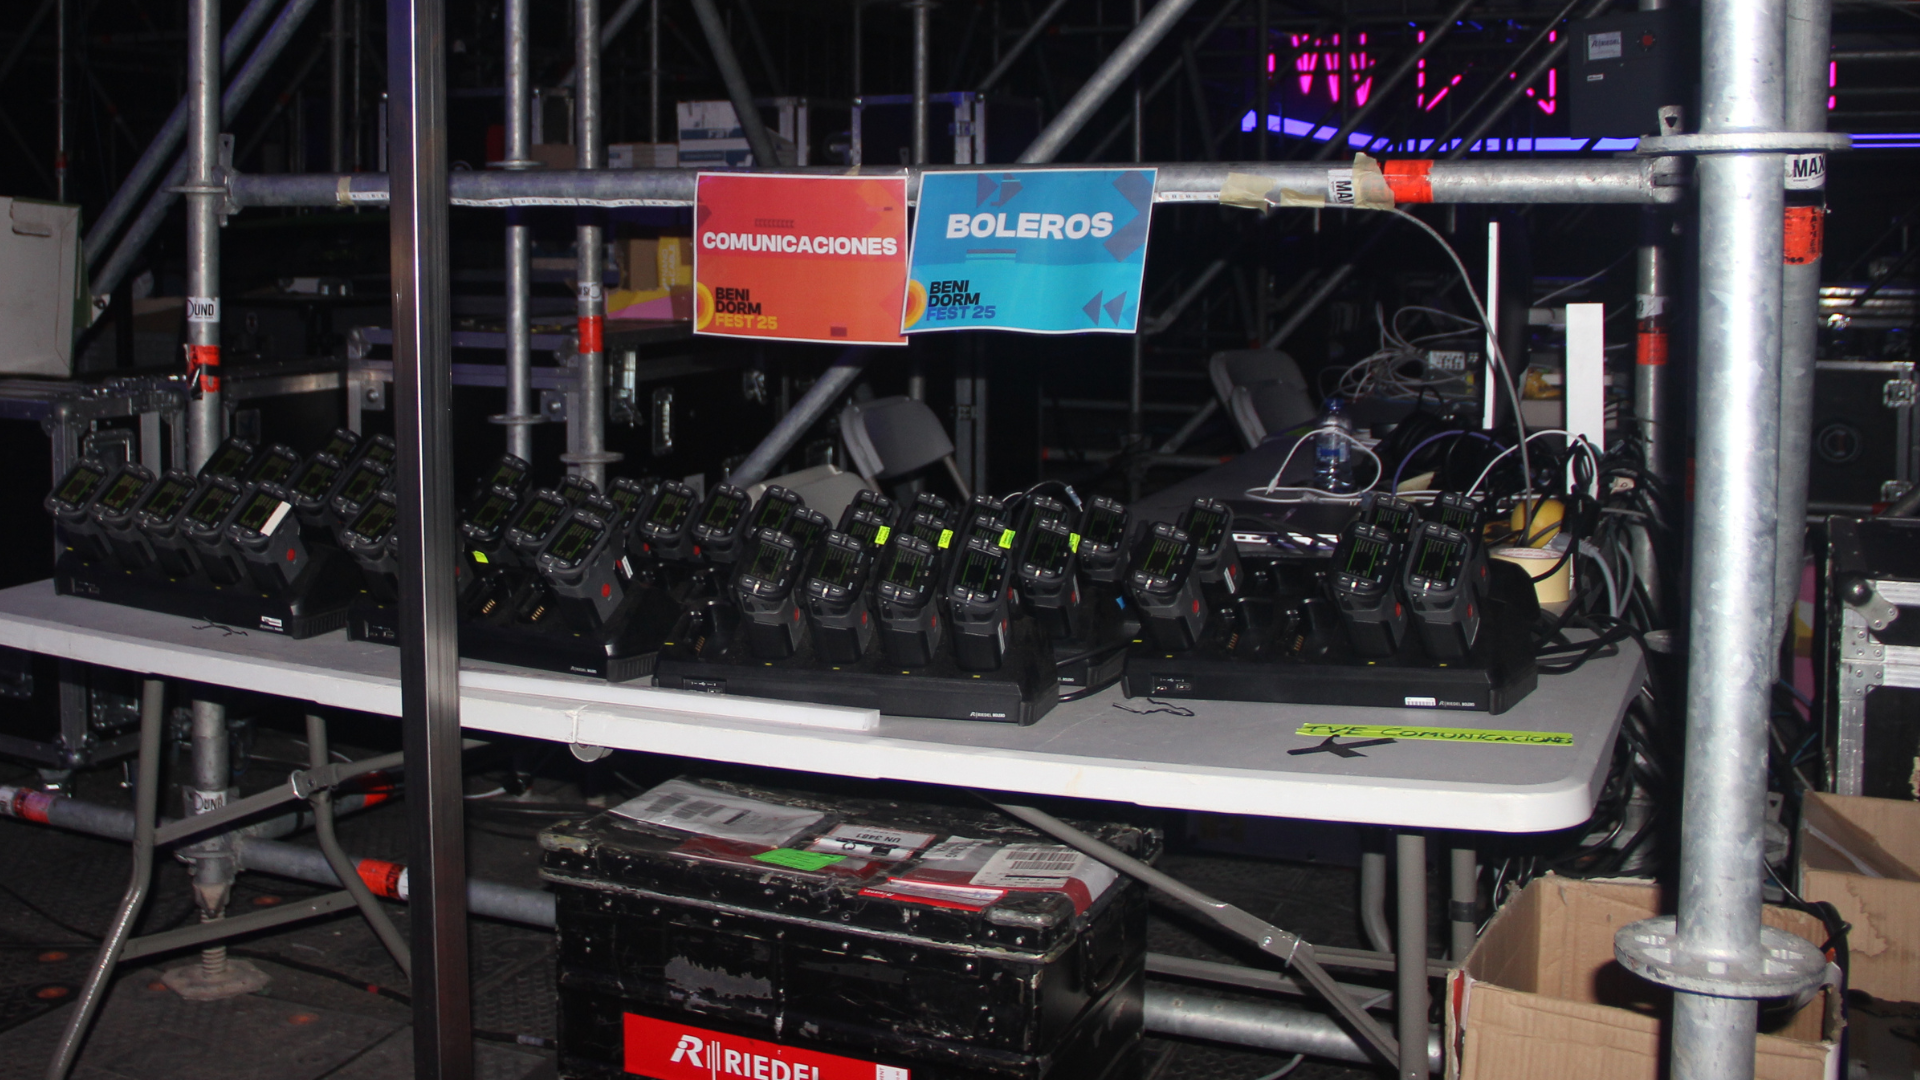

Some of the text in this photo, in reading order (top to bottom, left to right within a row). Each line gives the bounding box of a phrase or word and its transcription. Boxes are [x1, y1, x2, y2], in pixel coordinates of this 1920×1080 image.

[946, 211, 1114, 240] BOLEROS
[702, 231, 898, 256] COMUNICACIONES
[715, 286, 750, 302] BENI
[930, 279, 969, 295] BENI
[715, 300, 762, 315] DORM
[928, 292, 980, 308] DORM
[715, 312, 778, 330] FEST 25
[926, 305, 996, 321] FEST 25
[1304, 725, 1368, 735] TVE
[856, 832, 901, 843] UN 3481
